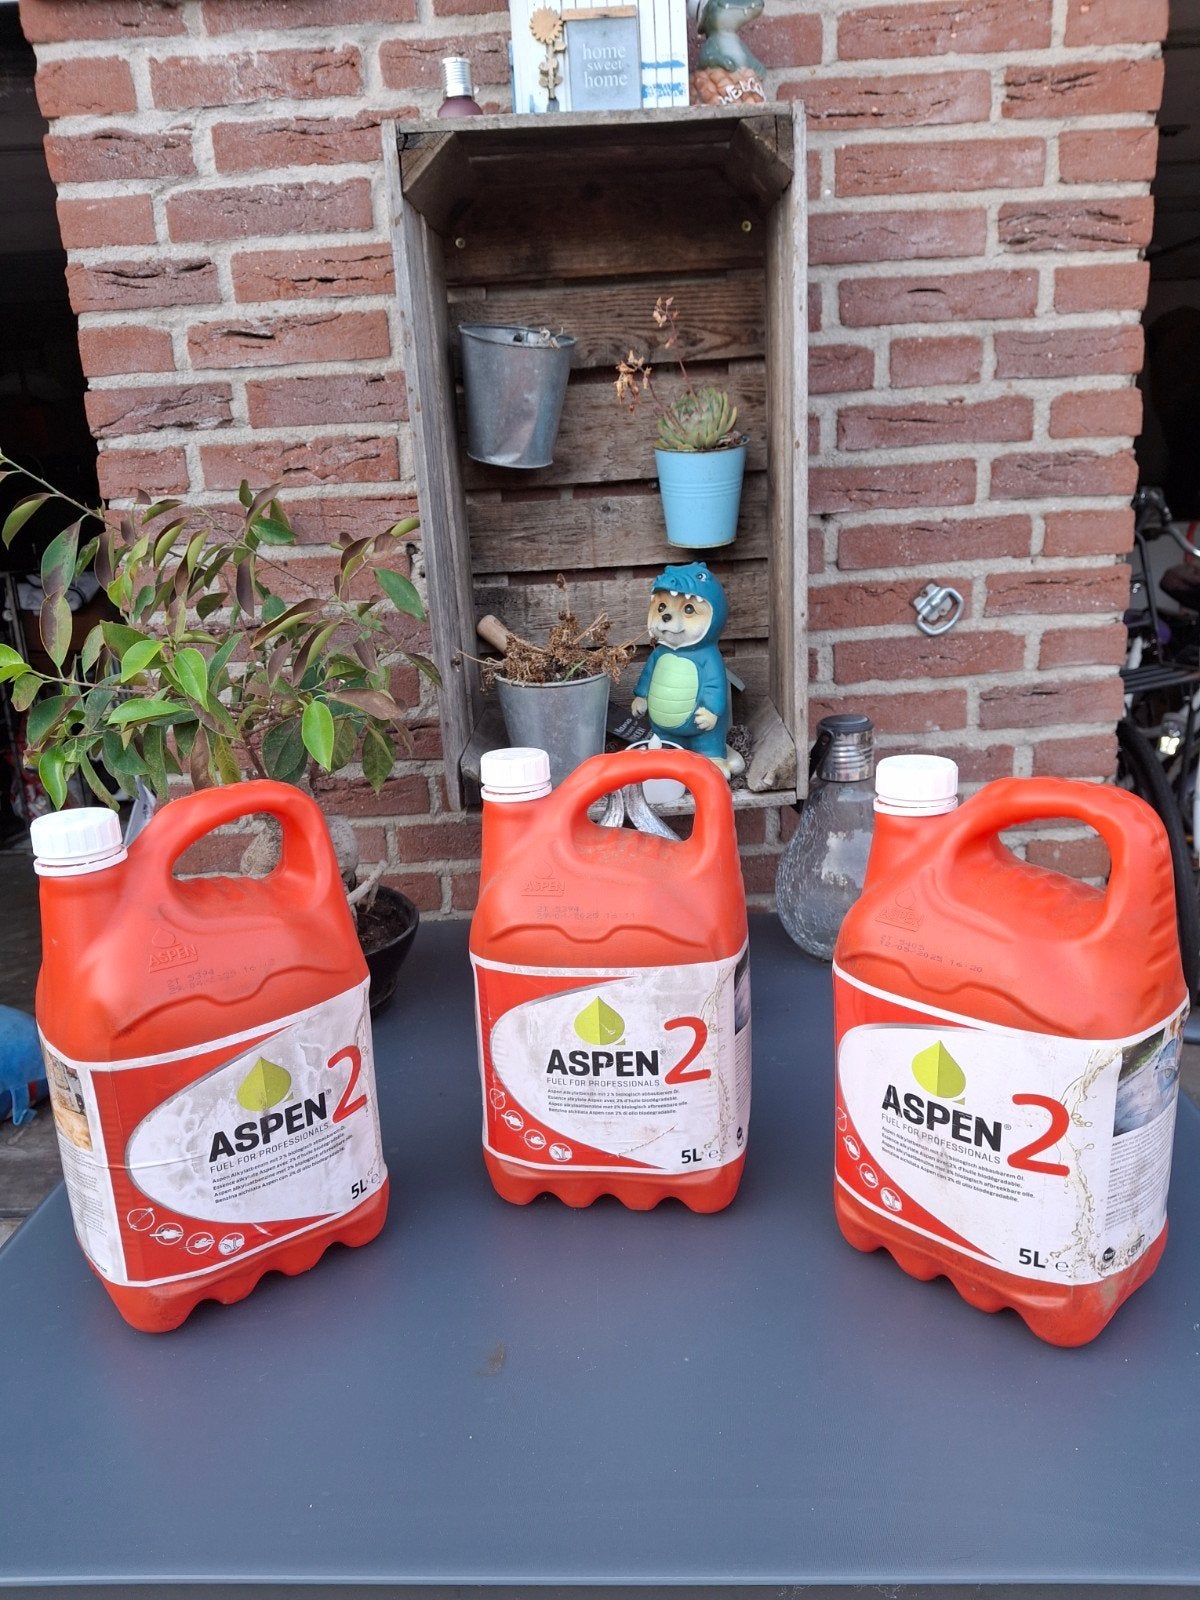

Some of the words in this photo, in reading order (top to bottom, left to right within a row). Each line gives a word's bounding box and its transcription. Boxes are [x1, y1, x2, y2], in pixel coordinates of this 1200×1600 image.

[583, 43, 626, 60] home
[587, 60, 623, 71] sweet
[584, 71, 628, 88] home
[148, 944, 198, 967] ASPEN
[546, 1049, 660, 1077] ASPEN
[664, 1016, 711, 1085] 2
[546, 1077, 567, 1086] FUEL
[569, 1079, 586, 1087] FOR
[588, 1079, 660, 1088] PROFESSIONALS
[209, 1092, 328, 1163] ASPEN
[327, 1045, 368, 1124] 2
[881, 1084, 1002, 1153] ASPEN
[1007, 1093, 1070, 1177] 2
[881, 1112, 902, 1129] FUEL
[903, 1122, 921, 1137] FOR
[921, 1129, 1001, 1165] PROFESSIONALS
[210, 1161, 234, 1174] FUEL
[237, 1154, 256, 1165] FOR
[258, 1122, 330, 1158] PROFESSIONALS
[681, 1148, 703, 1164] 5L
[351, 1179, 367, 1200] 5L
[1018, 1247, 1046, 1269] 5L
